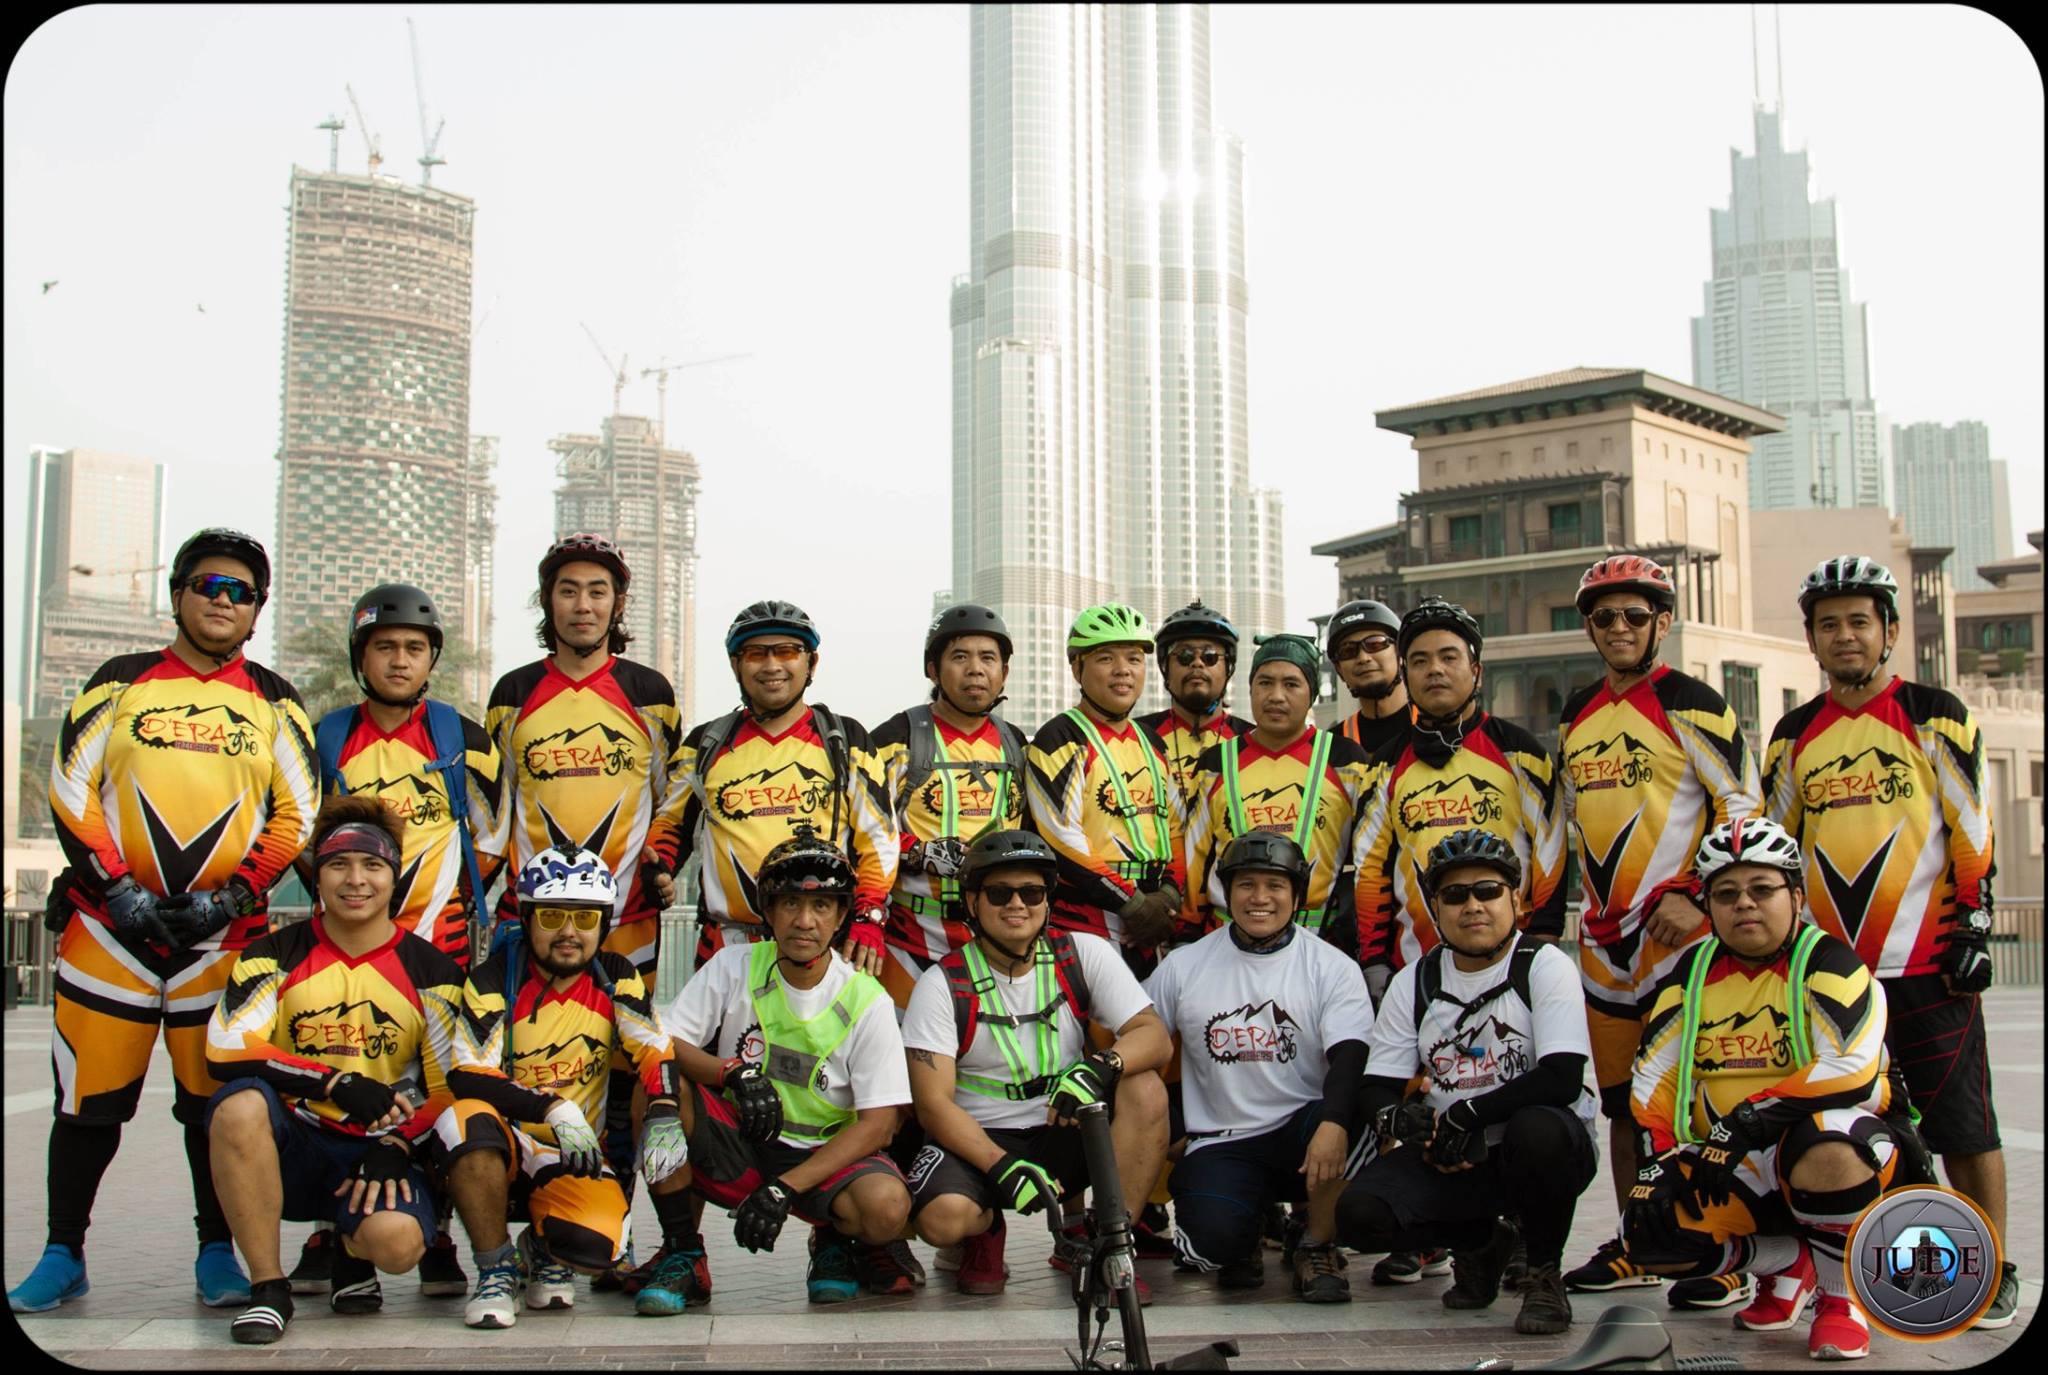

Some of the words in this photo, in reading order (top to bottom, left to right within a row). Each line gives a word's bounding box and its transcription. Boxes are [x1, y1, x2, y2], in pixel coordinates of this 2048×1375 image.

[140, 717, 227, 745] D'ERA
[528, 745, 606, 769] D'ERA
[723, 783, 802, 809] D'ERA
[1807, 770, 1878, 803] D'ERA
[1247, 803, 1299, 824] 'ERA
[1405, 794, 1474, 822] D'ERA
[297, 1023, 368, 1046] D'ERA
[1210, 1026, 1280, 1053] D'ERA
[1695, 1031, 1774, 1059] D'ERA
[1701, 1145, 1731, 1165] FOX
[1628, 1184, 1656, 1200] FOX
